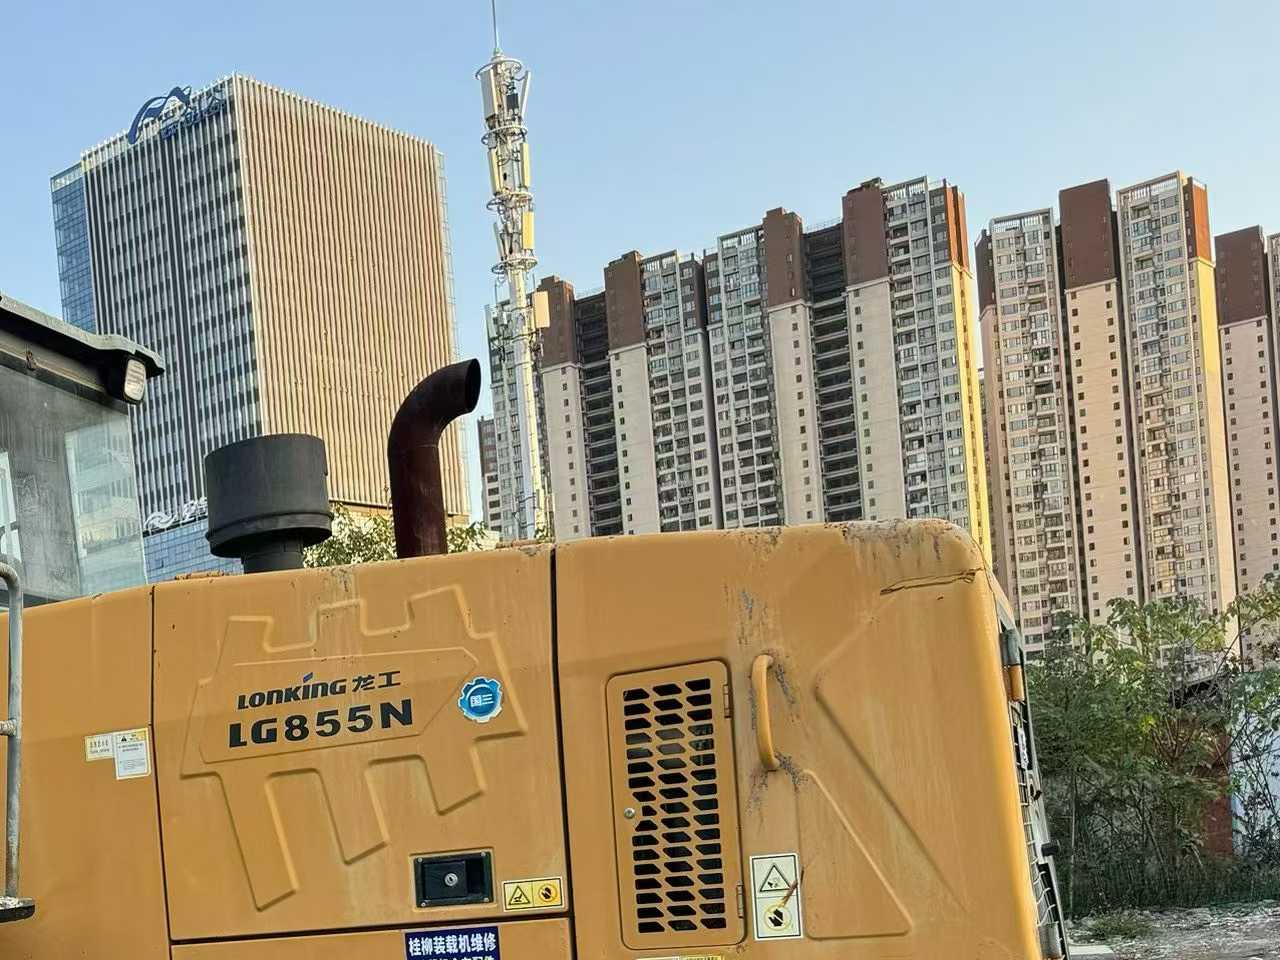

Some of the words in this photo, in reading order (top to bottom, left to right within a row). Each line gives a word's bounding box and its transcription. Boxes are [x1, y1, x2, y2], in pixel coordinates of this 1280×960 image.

[351, 670, 401, 693] 龙工
[470, 693, 494, 707] 国三
[228, 698, 413, 748] LG855N
[408, 932, 497, 956] 桂柳装载机维修
